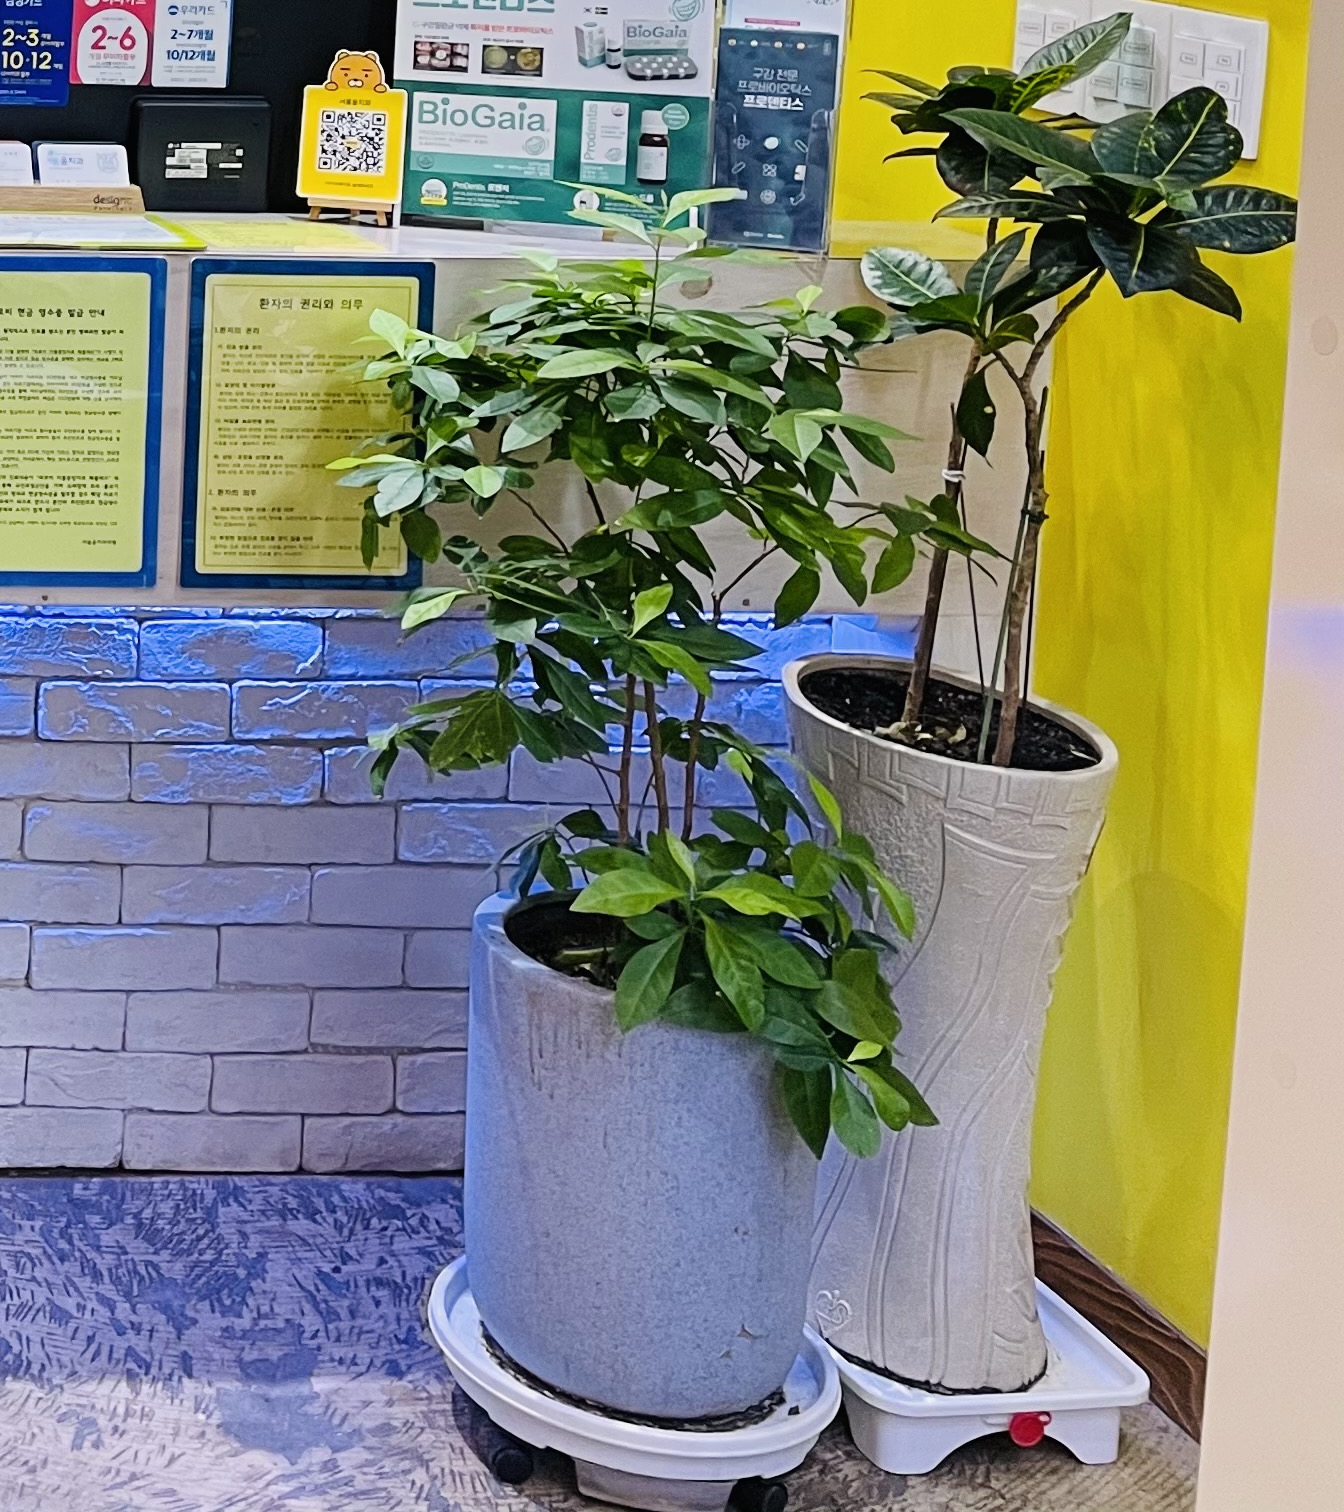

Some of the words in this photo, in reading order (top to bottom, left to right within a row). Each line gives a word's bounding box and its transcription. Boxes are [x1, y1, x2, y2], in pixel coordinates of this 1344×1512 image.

[180, 5, 215, 16] 우리카드
[2, 28, 40, 47] 2~3
[91, 25, 137, 51] 2~6
[170, 29, 214, 41] 2~7개월
[627, 25, 687, 38] BioGaia
[166, 49, 216, 62] 10/12개월
[743, 94, 804, 111] 프로덴티스
[417, 97, 546, 132] BioGaia
[583, 103, 598, 161] Prodentis
[260, 298, 293, 310] 환자의
[300, 298, 334, 310] 권리와
[340, 299, 363, 310] 의무
